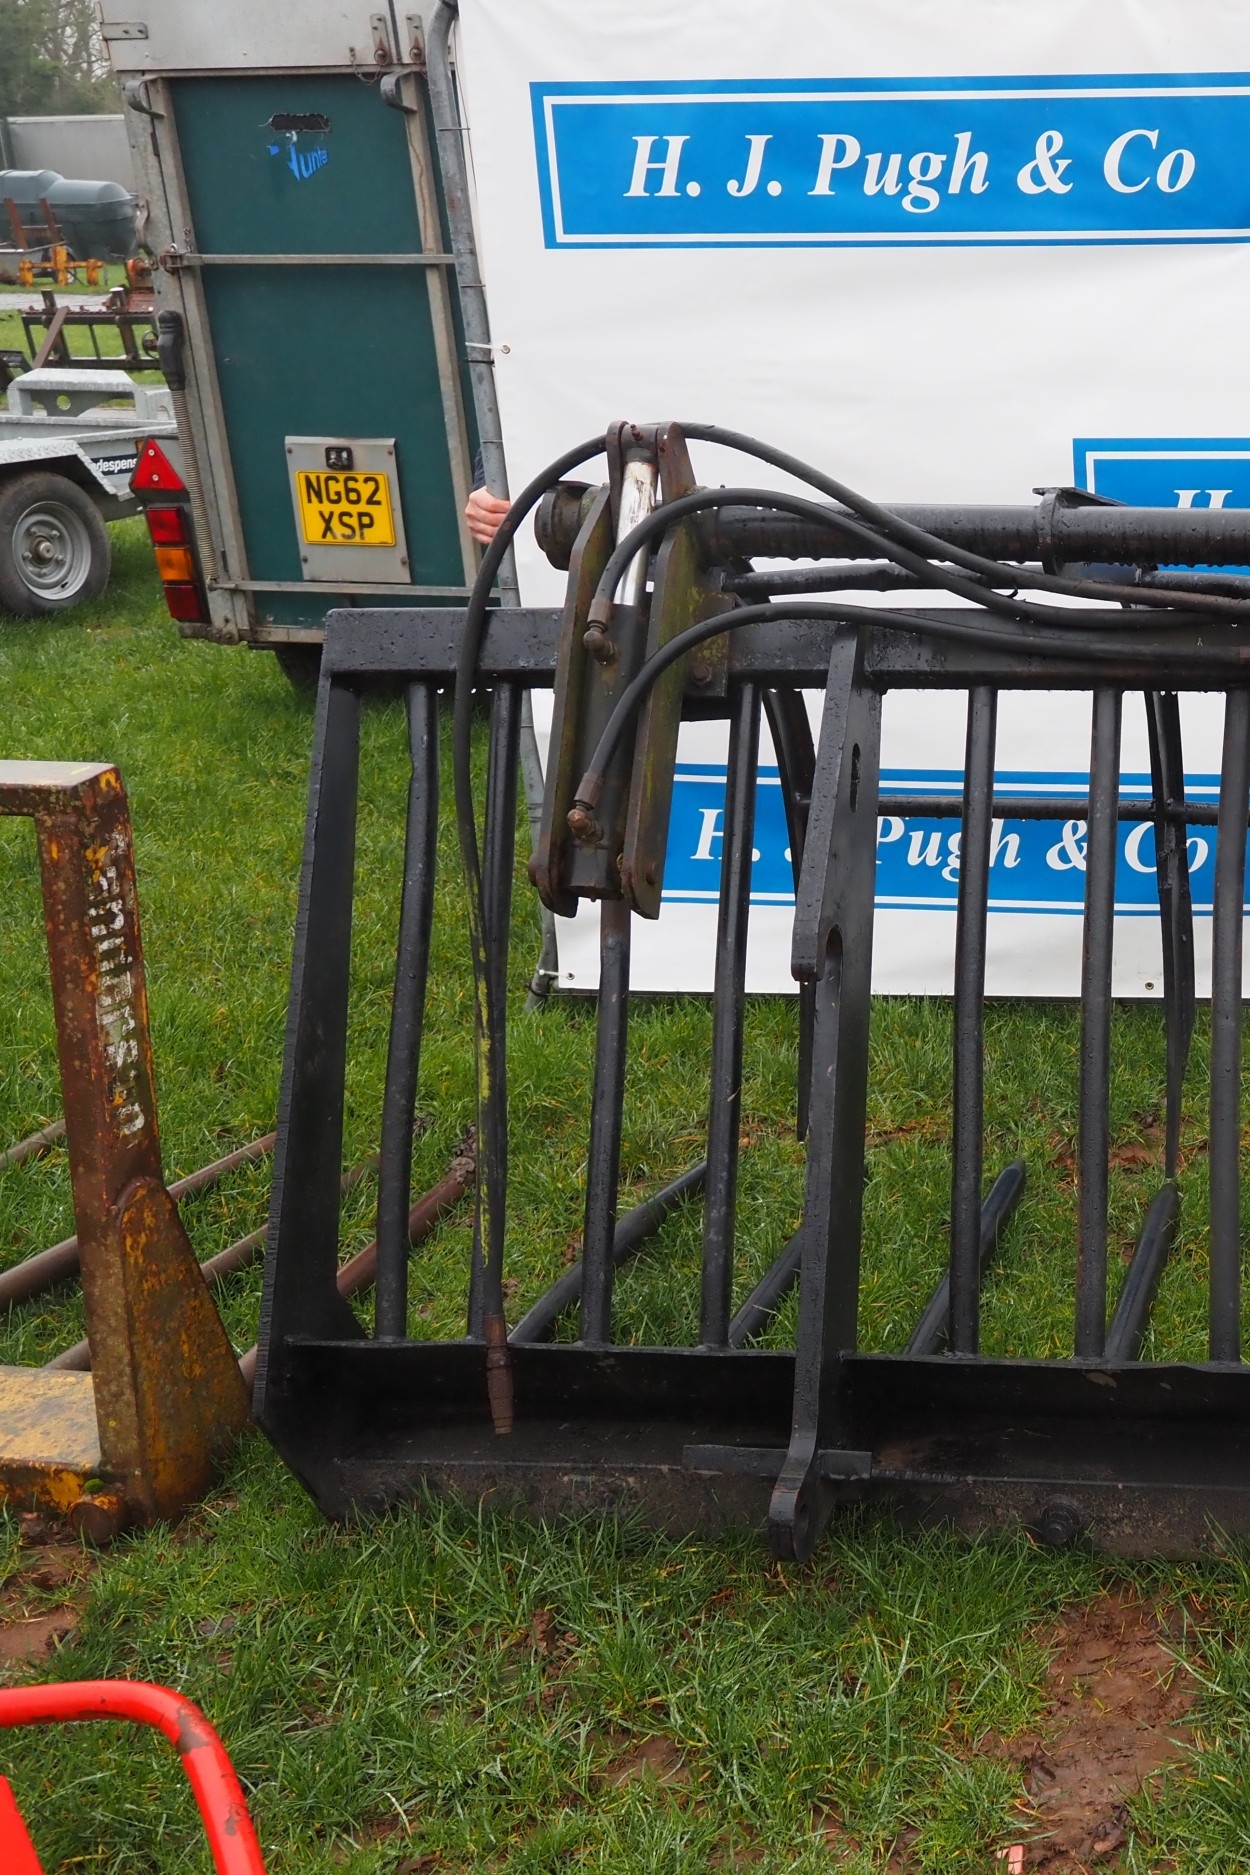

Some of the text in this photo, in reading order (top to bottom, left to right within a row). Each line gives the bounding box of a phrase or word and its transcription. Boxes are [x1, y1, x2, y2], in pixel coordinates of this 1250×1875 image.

[623, 128, 1196, 214] H. J. Pugh & Co
[304, 474, 382, 506] NG62
[318, 510, 375, 541] XSP
[1045, 819, 1089, 872] &
